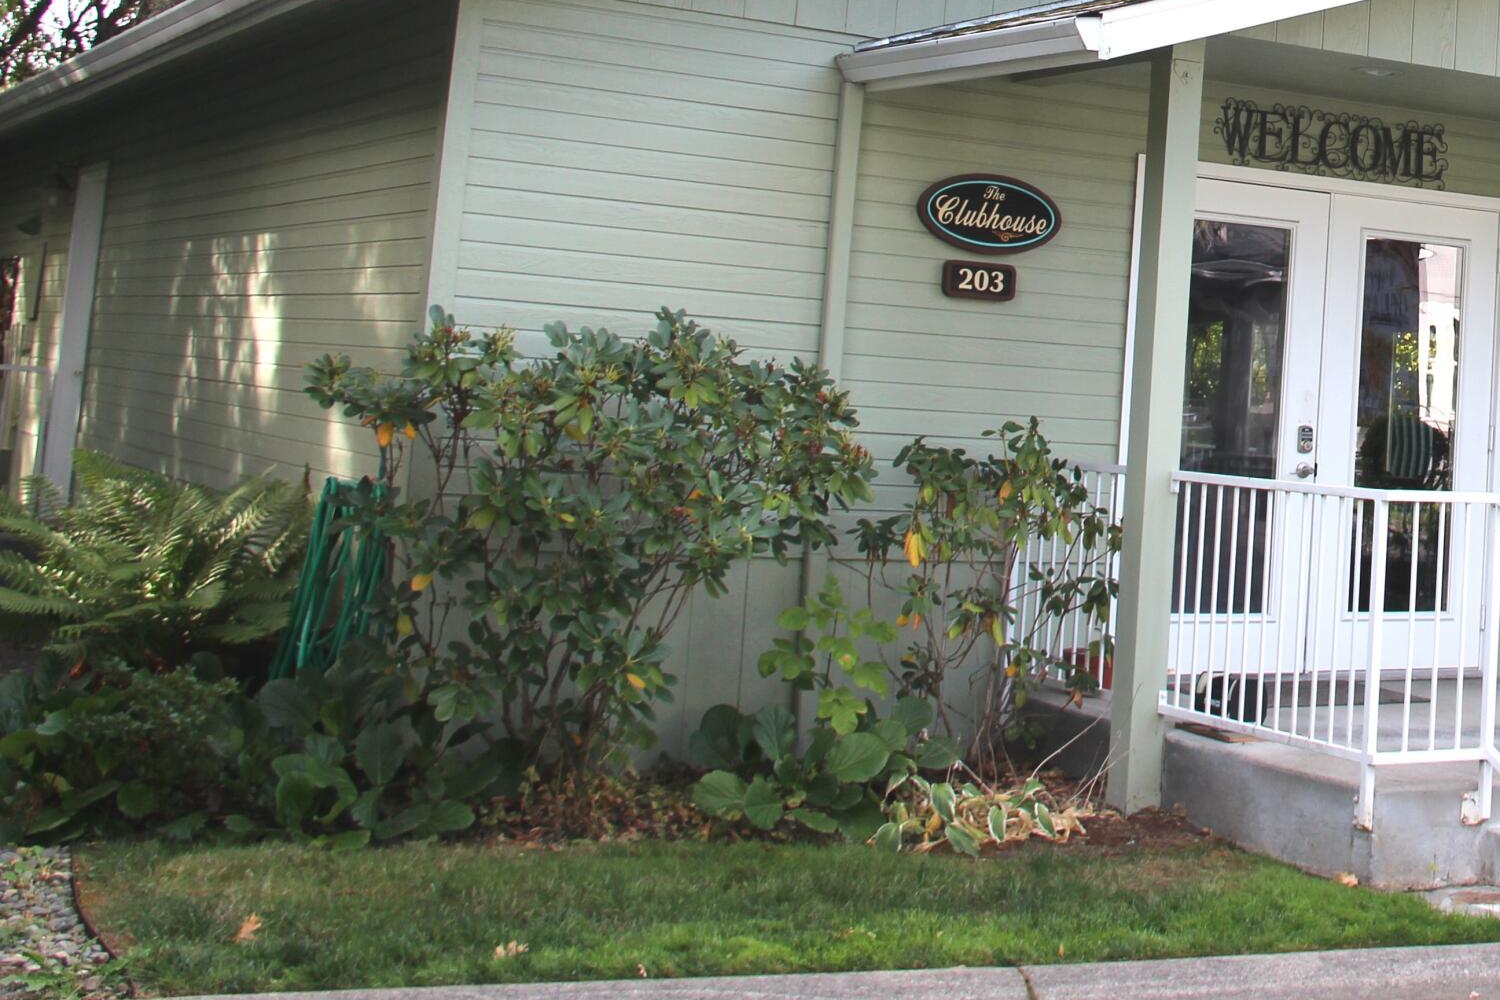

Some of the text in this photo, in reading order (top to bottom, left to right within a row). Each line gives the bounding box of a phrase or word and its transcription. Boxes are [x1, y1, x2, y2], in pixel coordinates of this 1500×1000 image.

[1217, 100, 1447, 185] WELCOME
[983, 185, 1006, 201] The
[936, 194, 1048, 235] Clubhouse
[958, 268, 1004, 293] 203
